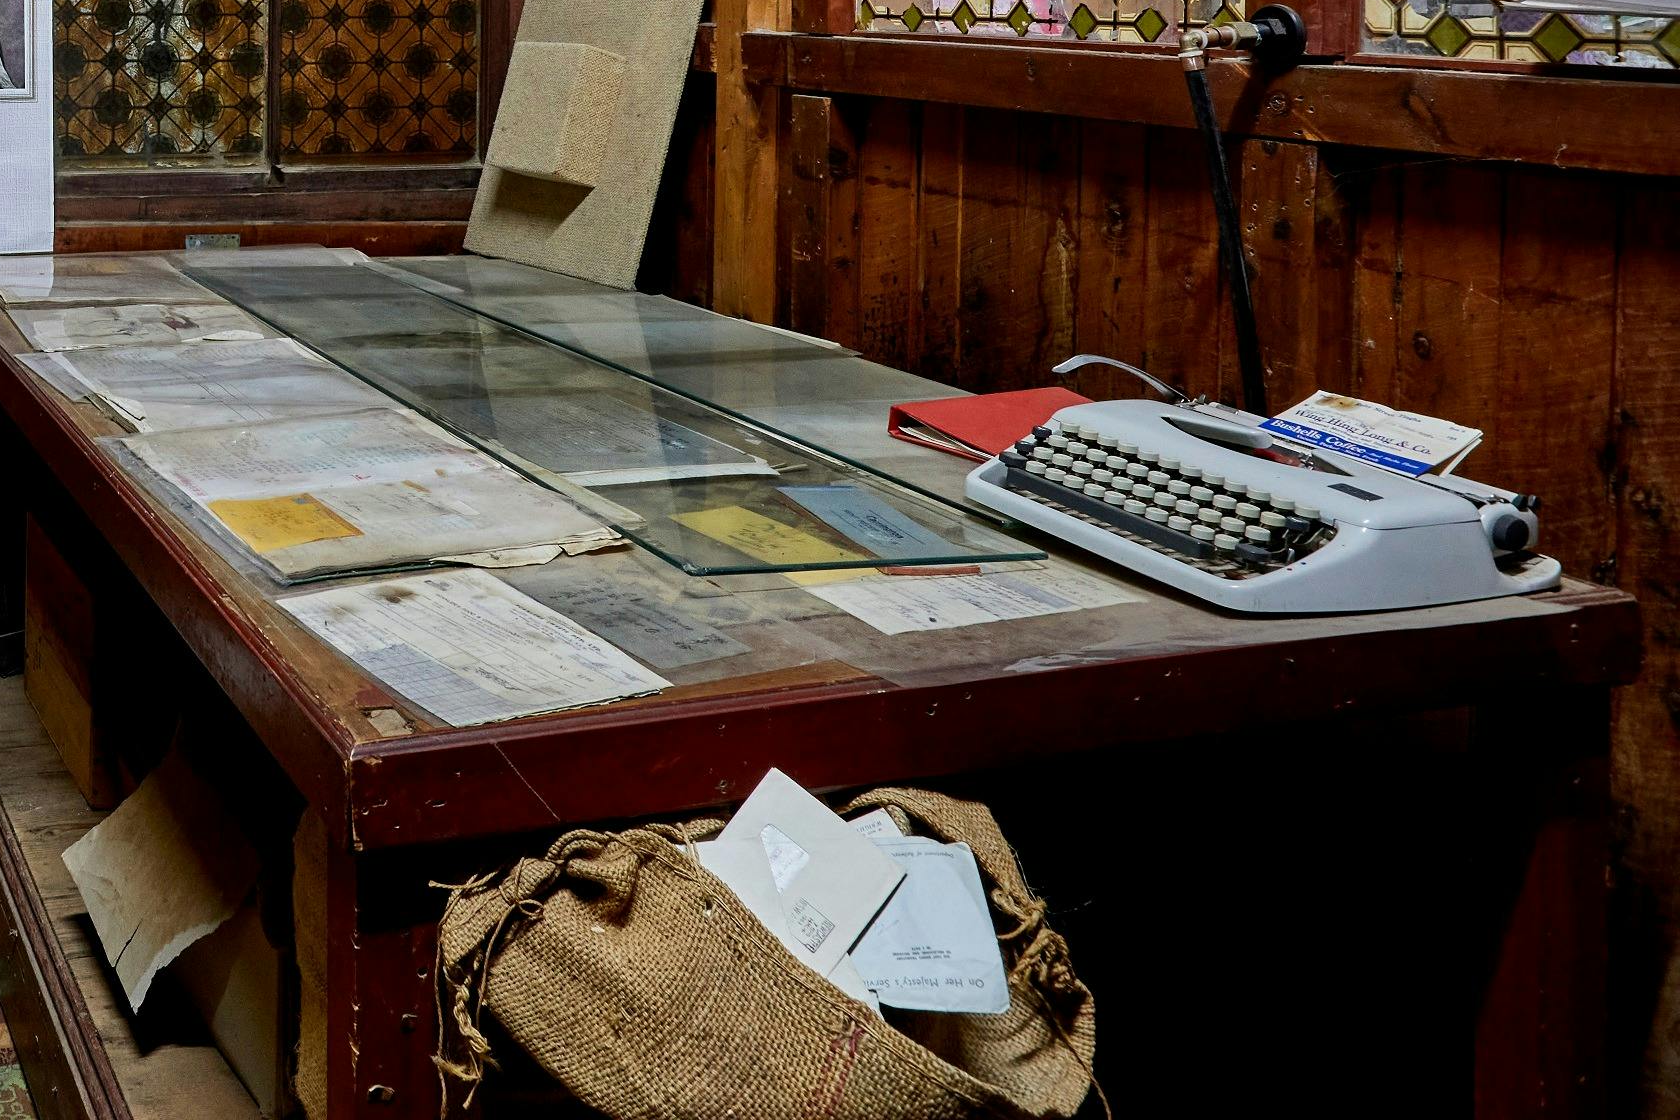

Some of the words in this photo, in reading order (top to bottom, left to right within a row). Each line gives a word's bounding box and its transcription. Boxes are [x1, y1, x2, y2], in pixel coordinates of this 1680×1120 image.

[1271, 419, 1322, 440] Bushells
[1325, 433, 1367, 454] Coffee
[1295, 409, 1324, 422] Wing
[1327, 417, 1359, 433] Hing
[1362, 427, 1391, 445] Long
[1395, 440, 1408, 448] &
[1412, 444, 1431, 455] Co.
[895, 976, 938, 988] Majesty's
[945, 978, 963, 987] Her
[968, 978, 985, 988] On
